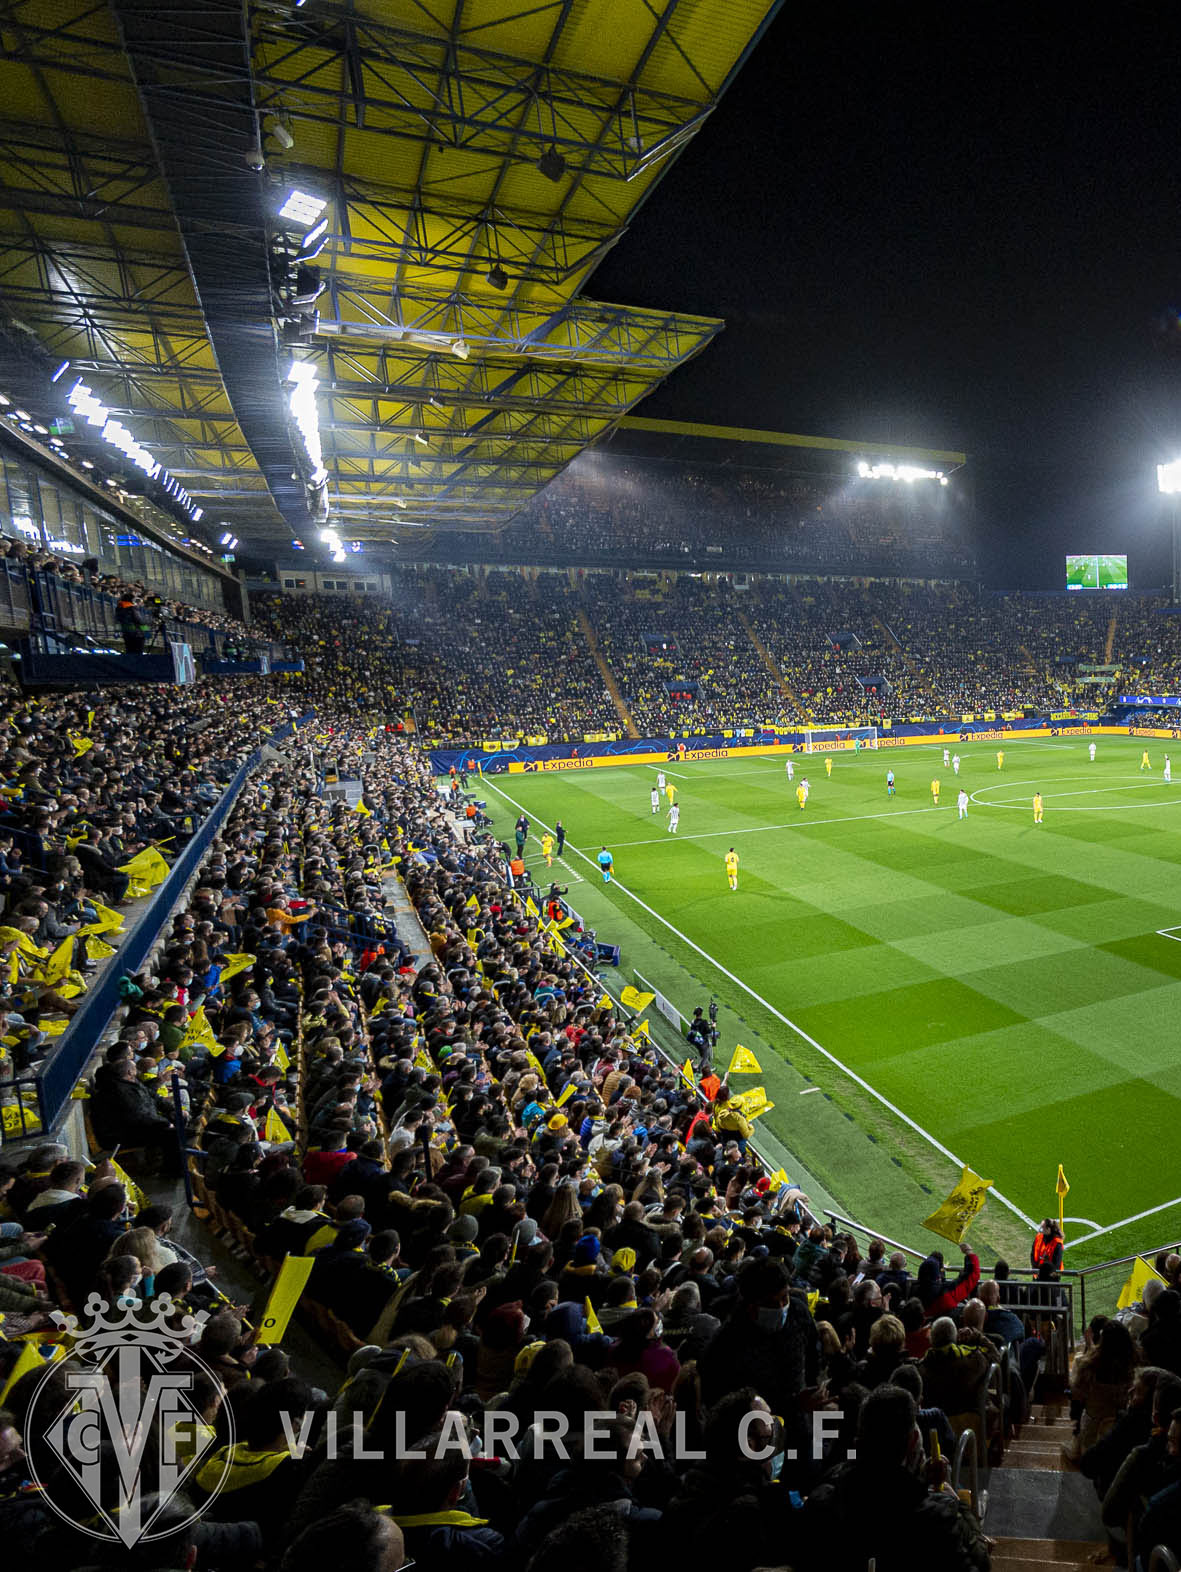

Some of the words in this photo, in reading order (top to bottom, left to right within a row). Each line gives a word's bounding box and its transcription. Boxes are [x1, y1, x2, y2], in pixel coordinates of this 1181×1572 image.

[971, 731, 1004, 741] Expedia
[1061, 726, 1092, 735] Expedia
[684, 748, 729, 760] Expedia
[543, 758, 593, 770] Expedia
